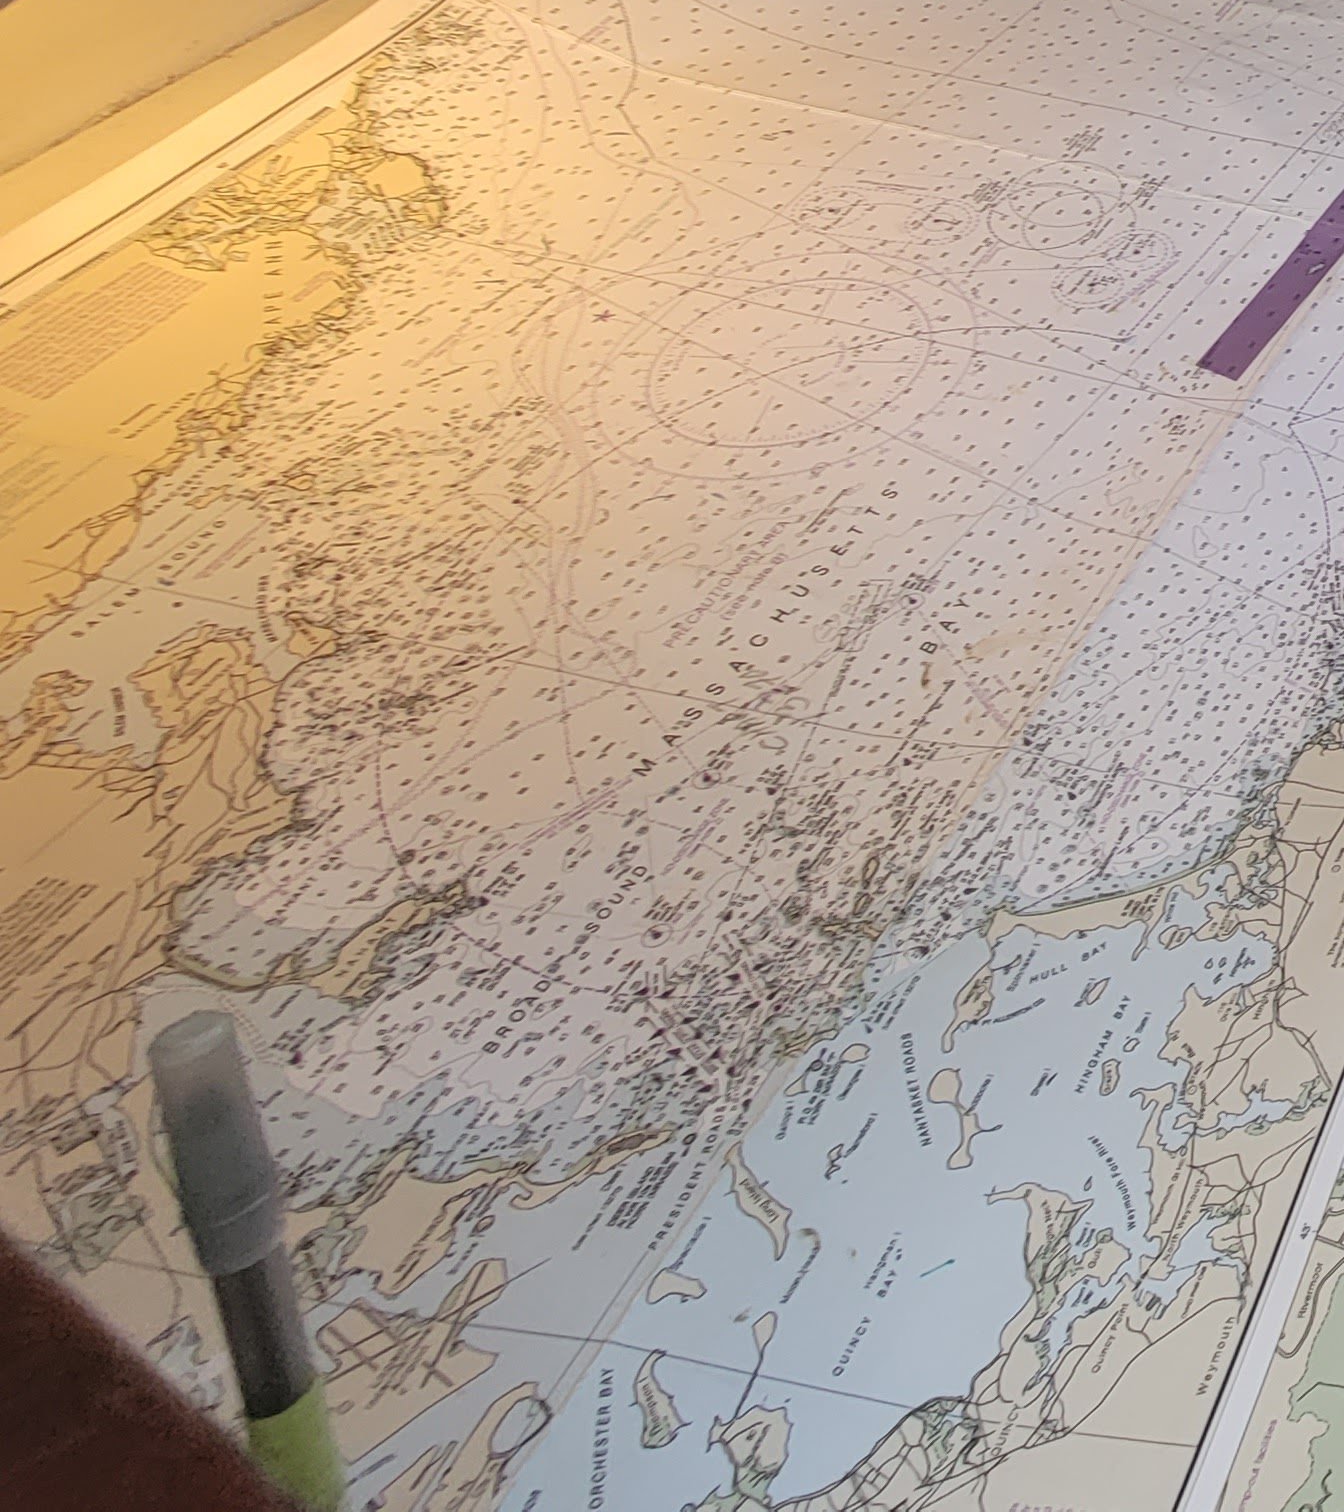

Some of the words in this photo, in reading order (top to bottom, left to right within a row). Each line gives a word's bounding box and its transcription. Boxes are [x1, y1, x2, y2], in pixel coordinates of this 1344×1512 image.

[1027, 964, 1069, 985] HULL
[1081, 942, 1108, 963] BAY
[1073, 1029, 1115, 1096] HINGHAM
[1112, 994, 1133, 1022] BAY
[646, 1162, 706, 1251] PRESIDENT
[831, 1315, 872, 1377] QUINCY
[1090, 1334, 1117, 1375] Quincy
[1109, 1302, 1130, 1335] Point
[1194, 1316, 1237, 1396] Weymouth
